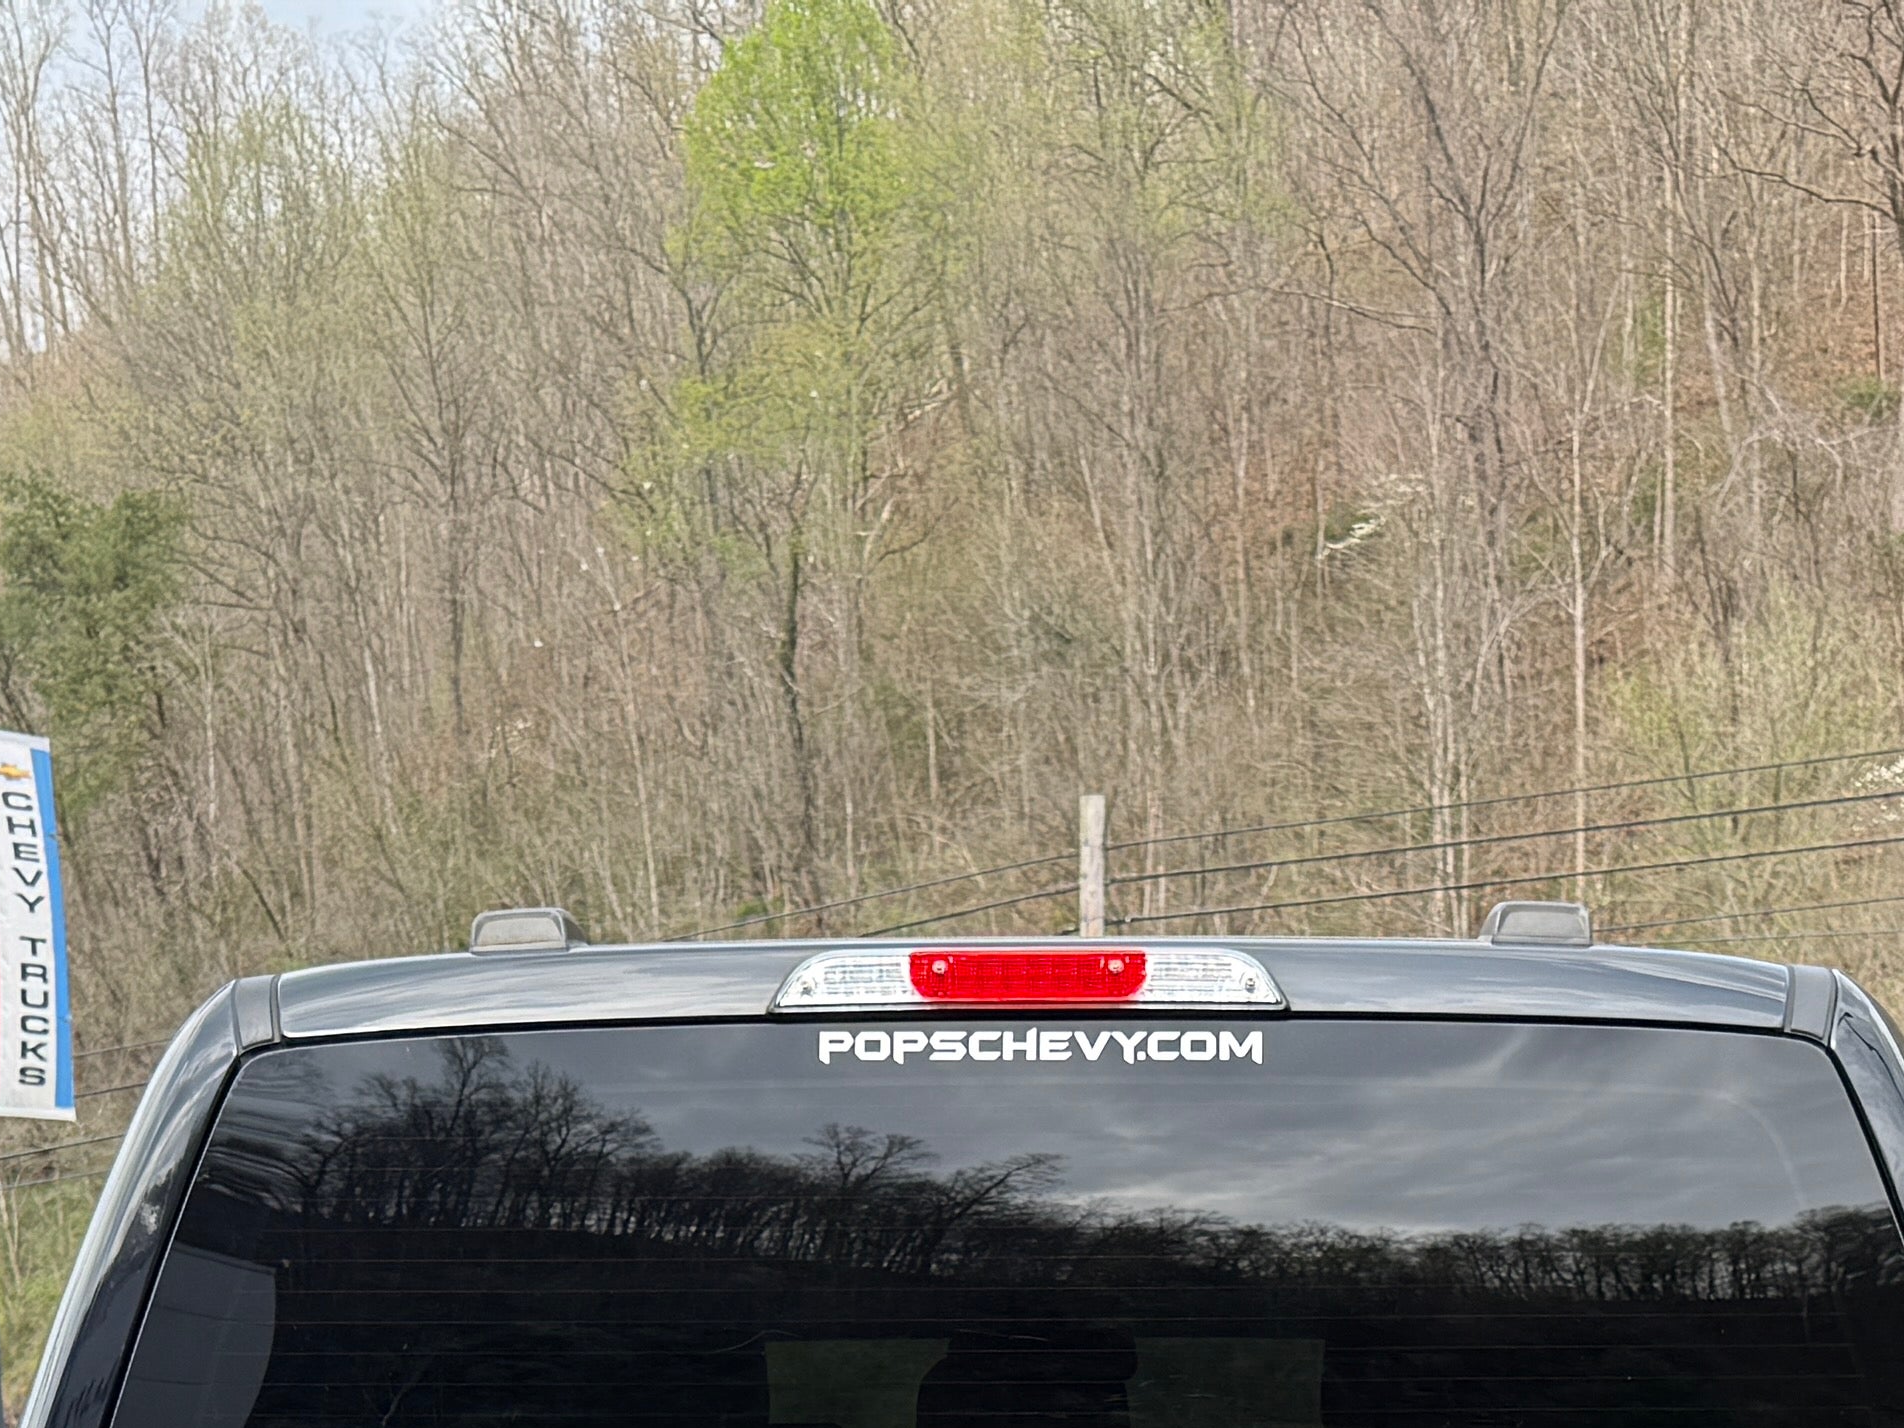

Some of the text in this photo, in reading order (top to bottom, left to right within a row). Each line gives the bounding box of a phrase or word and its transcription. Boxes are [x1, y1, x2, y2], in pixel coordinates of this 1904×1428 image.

[2, 791, 49, 1087] CHEVY TRUCKS
[818, 1027, 1263, 1065] POPSCHEVY.COM
